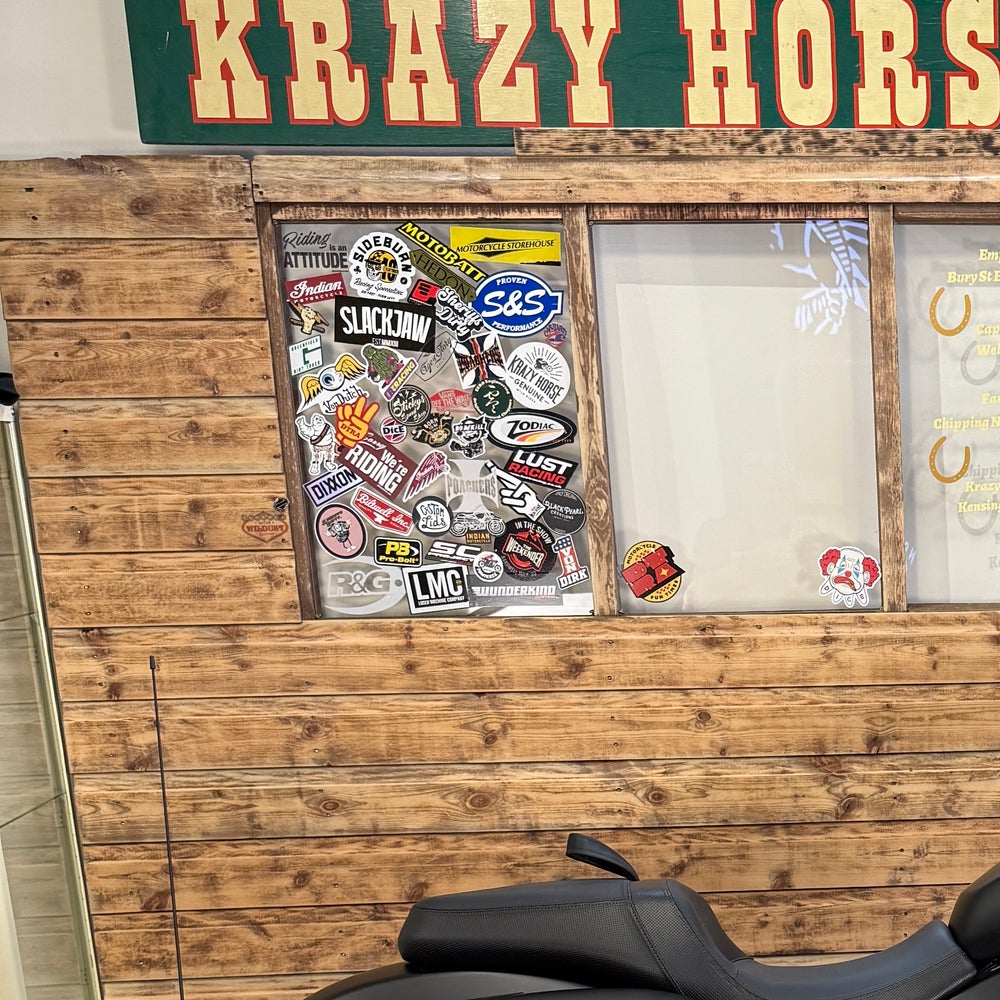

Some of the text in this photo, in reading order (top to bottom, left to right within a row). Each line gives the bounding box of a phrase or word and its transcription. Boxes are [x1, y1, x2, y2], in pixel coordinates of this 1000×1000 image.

[181, 0, 622, 128] KRAZY
[283, 231, 331, 249] Riding
[456, 240, 554, 252] MOTORCYCLE STOREHOUSE
[284, 252, 349, 269] ATTITUDE
[353, 236, 411, 272] SIDEBURN
[402, 223, 486, 281] MOTOBATT
[415, 254, 470, 299] HEDON
[496, 277, 527, 286] PROVEN
[947, 271, 977, 286] Bury
[979, 271, 992, 282] St
[290, 280, 342, 298] Indian
[481, 289, 546, 318] S&S
[339, 306, 432, 344] SLACKJAW
[436, 307, 470, 337] Dirty
[492, 318, 543, 332] PERFORMANCE
[507, 355, 539, 380] KRAZY
[534, 376, 564, 405] HORSE
[514, 379, 545, 402] GENUINE
[338, 385, 364, 405] Dutch
[340, 424, 361, 439] DTRA
[507, 420, 555, 439] ZODIAC
[933, 417, 990, 431] Chipping
[345, 444, 402, 493] RIDING
[380, 450, 408, 476] We're
[513, 450, 573, 475] LUST
[311, 468, 358, 500] DIXXON
[508, 462, 566, 486] RACING
[965, 481, 1000, 494] Krazy
[359, 493, 392, 518] Biltwell
[545, 500, 564, 512] BLACK
[550, 510, 574, 520] CREATIONS
[422, 516, 446, 529] Lids
[515, 521, 522, 529] IN
[524, 521, 536, 530] THE
[536, 526, 552, 544] SHOW
[385, 541, 410, 556] PB
[430, 541, 482, 558] SC
[506, 537, 545, 568] WEEKENDER
[627, 544, 656, 564] MOTORCYCLE
[565, 548, 577, 575] VON
[328, 570, 391, 597] R&G
[412, 569, 463, 600] LMC
[560, 568, 589, 587] DIRK
[476, 585, 556, 596] WUNDERKIND
